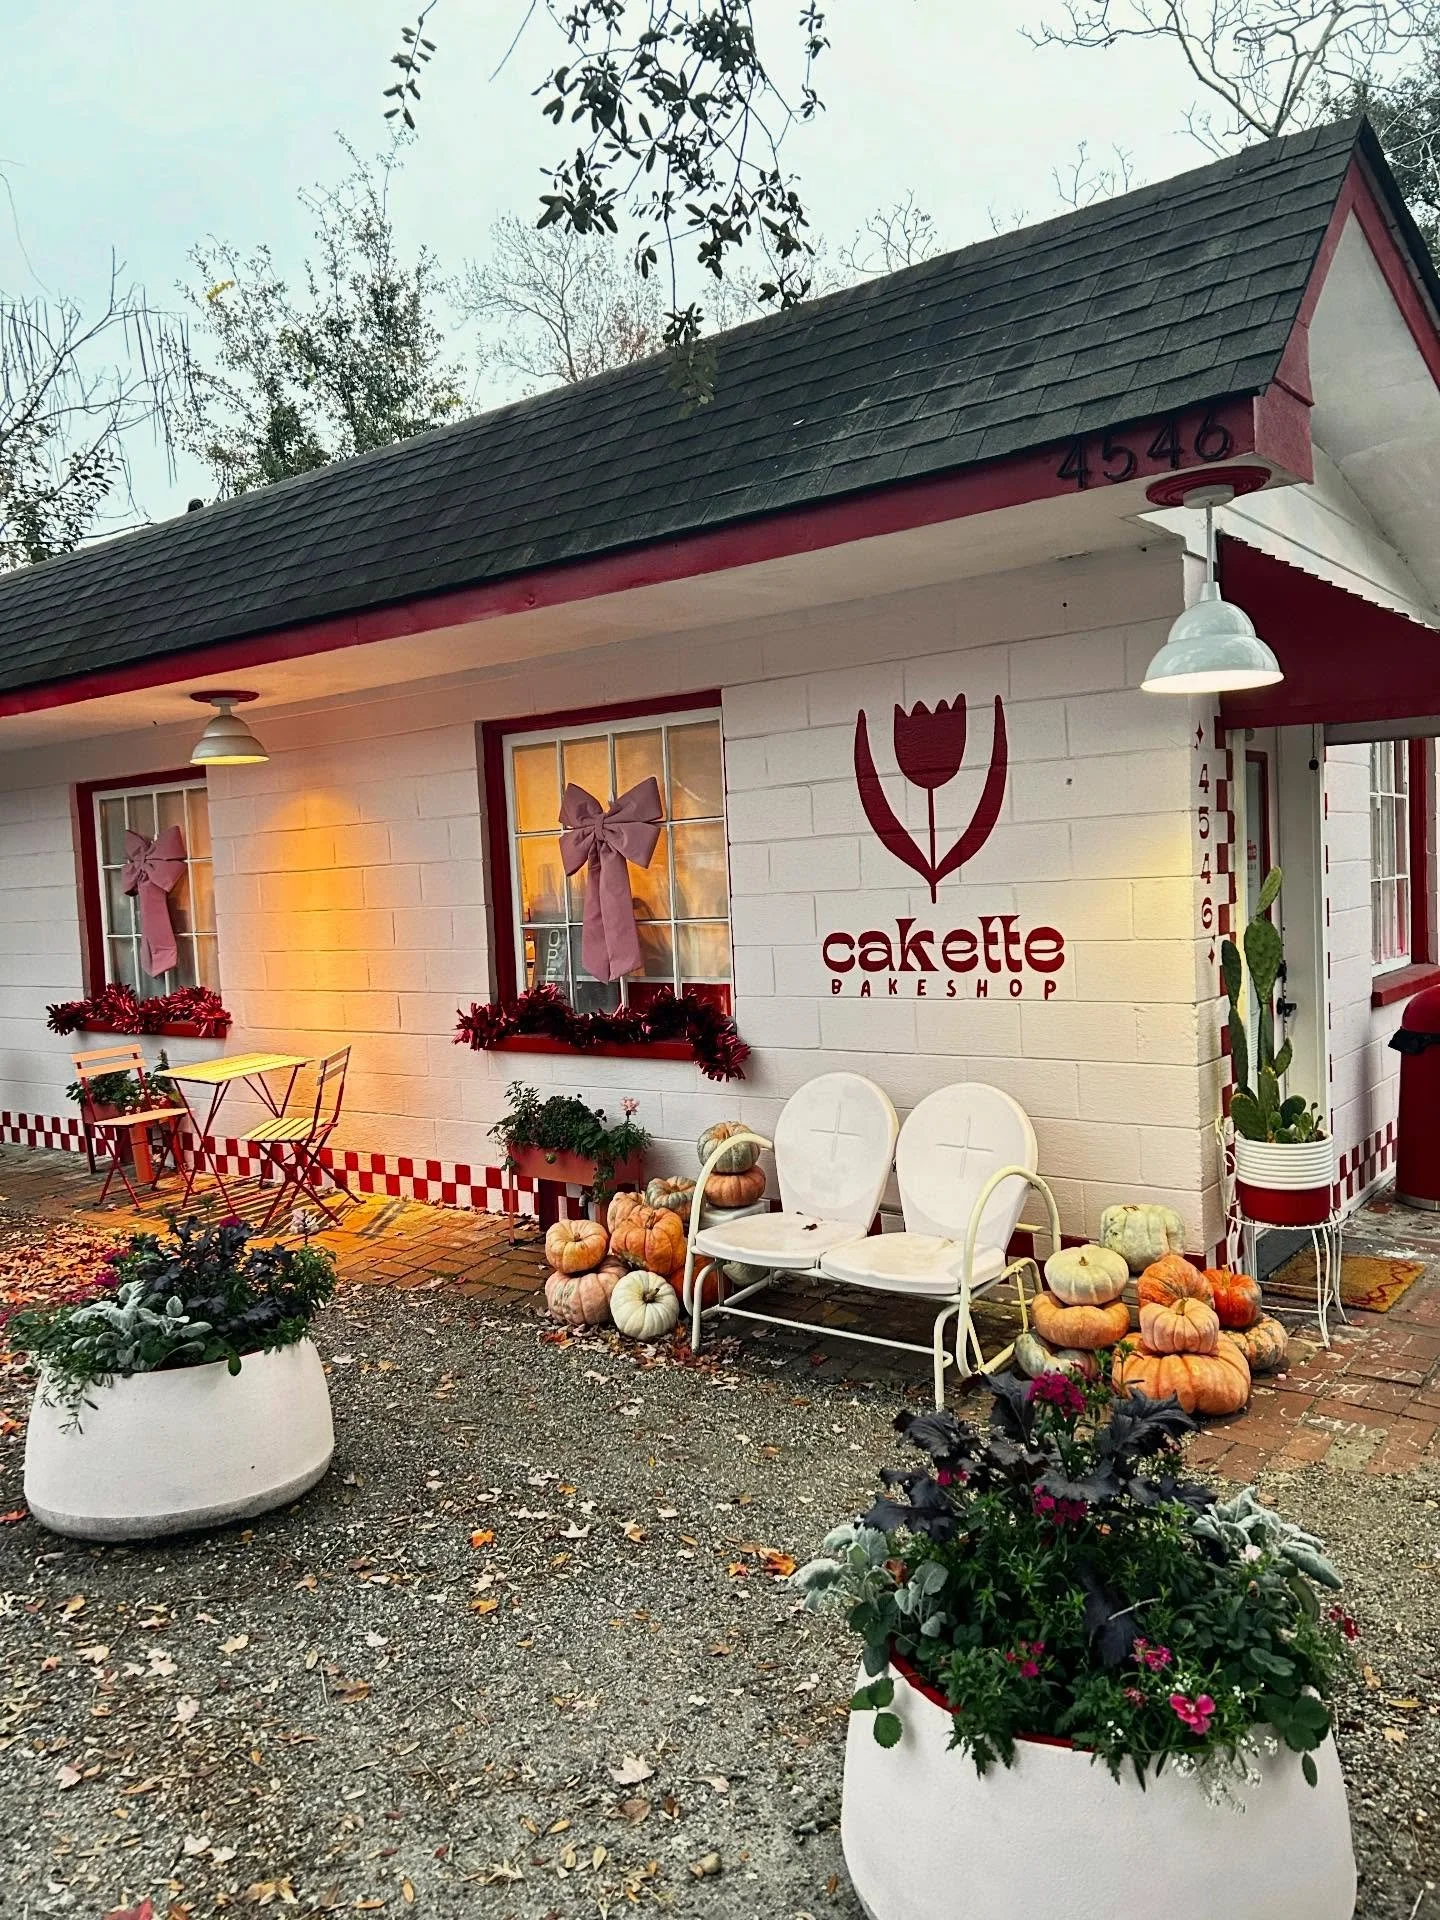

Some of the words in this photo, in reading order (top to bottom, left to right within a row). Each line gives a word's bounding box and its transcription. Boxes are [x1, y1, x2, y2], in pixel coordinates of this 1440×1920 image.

[1056, 414, 1231, 489] 4546
[1198, 763, 1213, 930] 4546
[545, 929, 560, 984] OPE
[822, 914, 1065, 974] cakette
[831, 978, 1057, 1000] BAKESHOP
